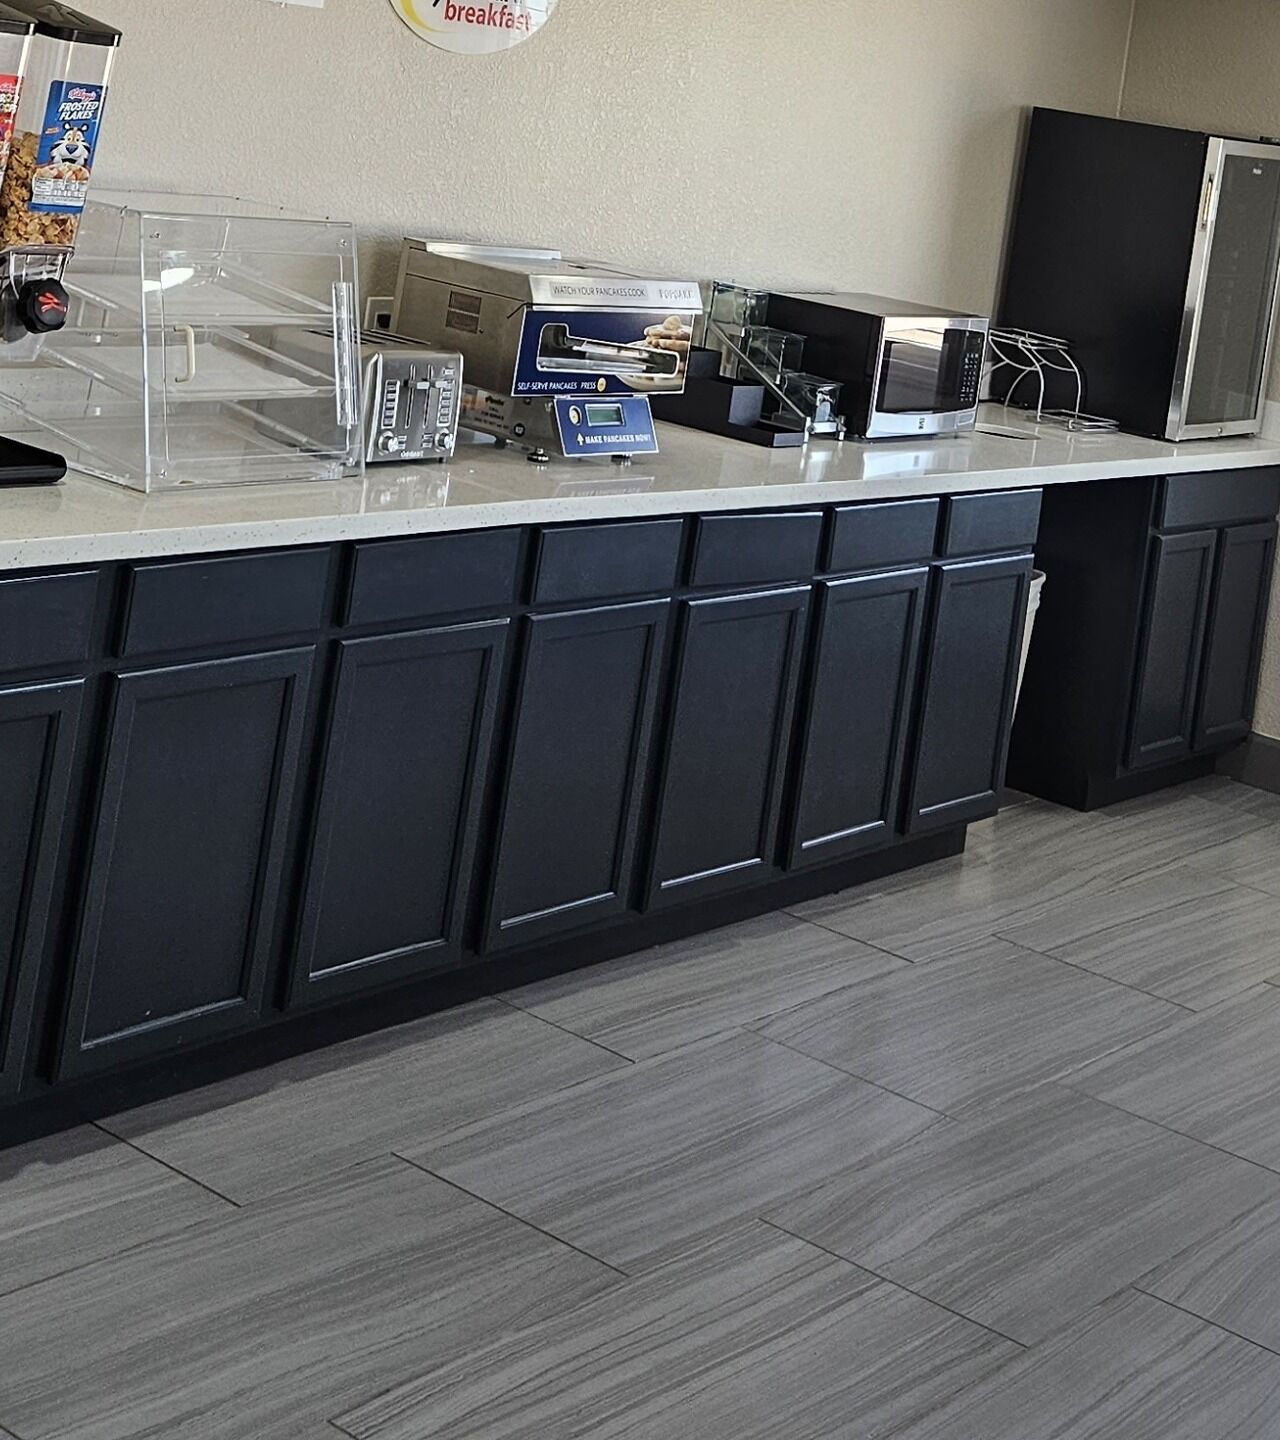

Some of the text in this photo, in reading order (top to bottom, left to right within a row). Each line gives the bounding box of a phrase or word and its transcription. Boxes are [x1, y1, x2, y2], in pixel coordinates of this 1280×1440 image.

[58, 101, 100, 112] FROSTED
[59, 110, 95, 121] FLAKES
[552, 286, 646, 298] WATCH YOUR PANCAKES COOK
[517, 381, 597, 391] SELF-SERVE PANCAKES PRESS
[585, 435, 601, 445] MAKE
[603, 434, 635, 444] PANCAKES
